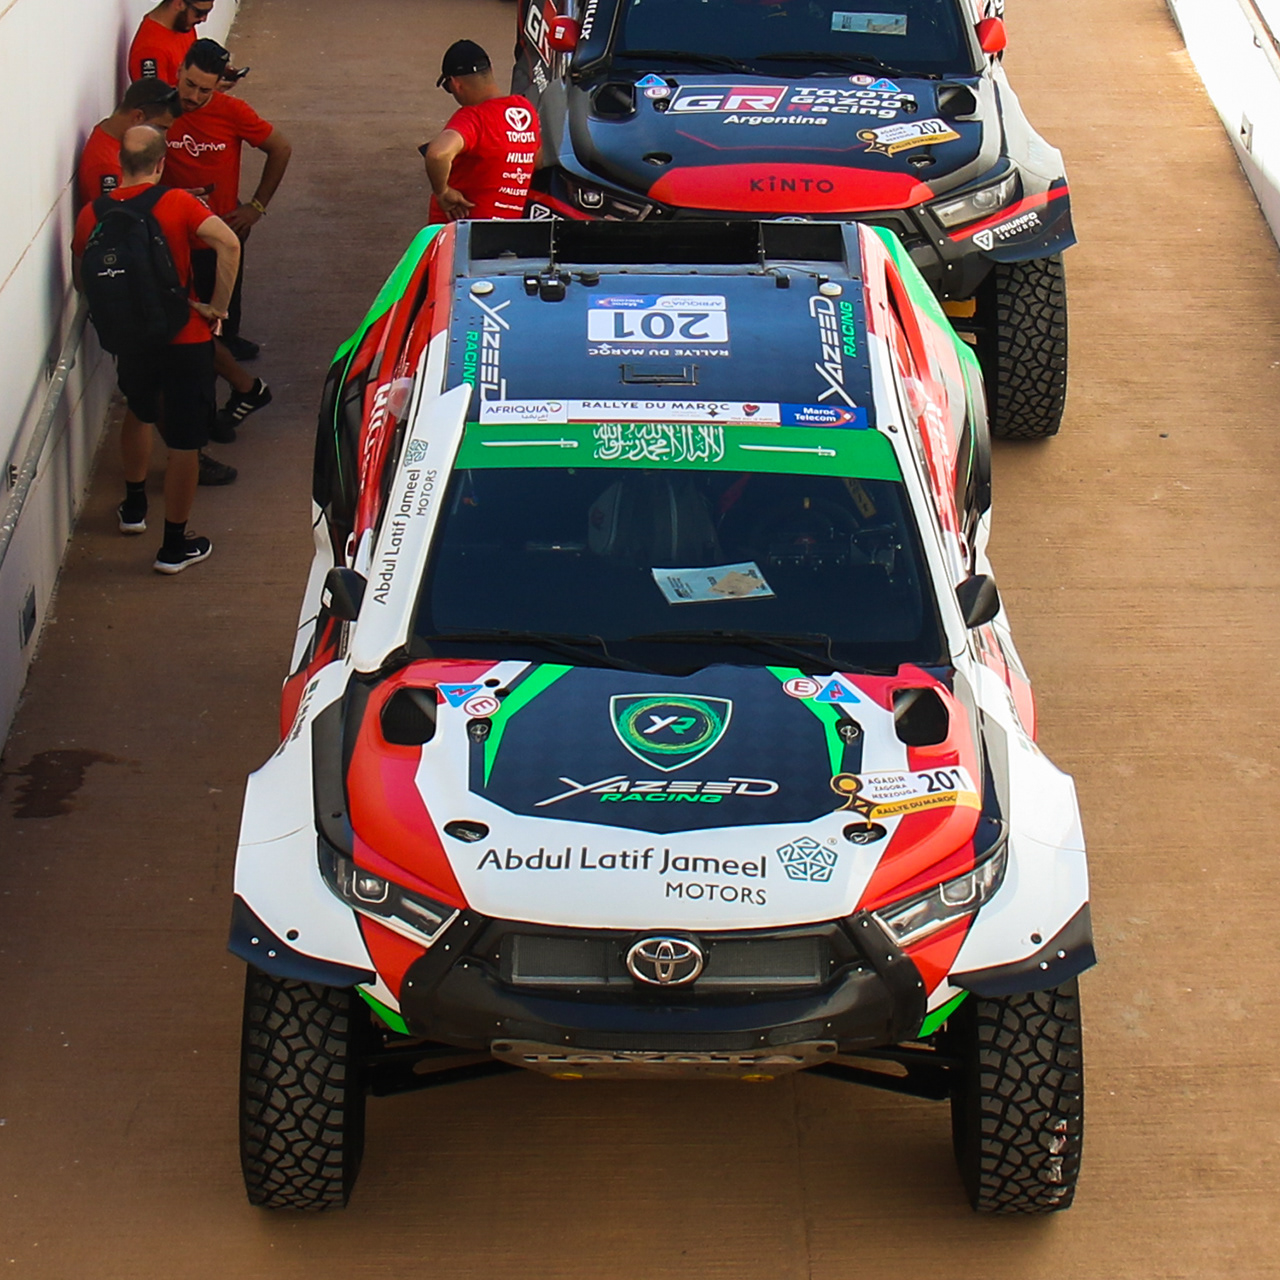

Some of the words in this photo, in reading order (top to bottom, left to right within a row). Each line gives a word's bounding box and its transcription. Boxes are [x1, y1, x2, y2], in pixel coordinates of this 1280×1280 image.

[673, 94, 776, 112] GR
[793, 87, 915, 101] TOYOTA
[790, 95, 902, 109] GAZOO
[723, 113, 828, 126] Argentina
[786, 103, 898, 118] Racing
[506, 131, 536, 143] TOYOTA
[912, 121, 947, 135] 202
[506, 152, 535, 163] HILUX
[993, 211, 1038, 235] TRIUNFO
[614, 312, 710, 340] 201
[839, 300, 857, 358] RACING
[589, 348, 645, 357] MAROC
[675, 348, 729, 357] RALLYE
[809, 295, 857, 409] YAZEED
[485, 404, 549, 414] AFRIQUIA
[582, 401, 639, 409] RALLYE
[645, 401, 666, 409] DU
[671, 402, 730, 412] MAROC
[803, 407, 836, 416] Maroc
[794, 413, 837, 422] Telecom
[395, 469, 422, 519] Jameel
[416, 469, 437, 517] MOTORS
[385, 521, 407, 557] Latif
[373, 560, 397, 605] Abdul
[793, 680, 810, 693] E
[868, 776, 907, 785] AGADIR
[917, 769, 963, 794] 201
[874, 783, 908, 791] ZAGORA
[534, 775, 780, 807] YAZEED
[600, 792, 723, 803] RACING
[871, 788, 918, 800] MERZOUGA
[877, 802, 909, 816] RALLYE
[910, 801, 923, 809] DU
[921, 795, 957, 807] MAROC
[476, 847, 571, 870] Abdul
[579, 847, 655, 870] Latif
[659, 848, 767, 878] Jameel
[664, 881, 767, 906] MOTORS
